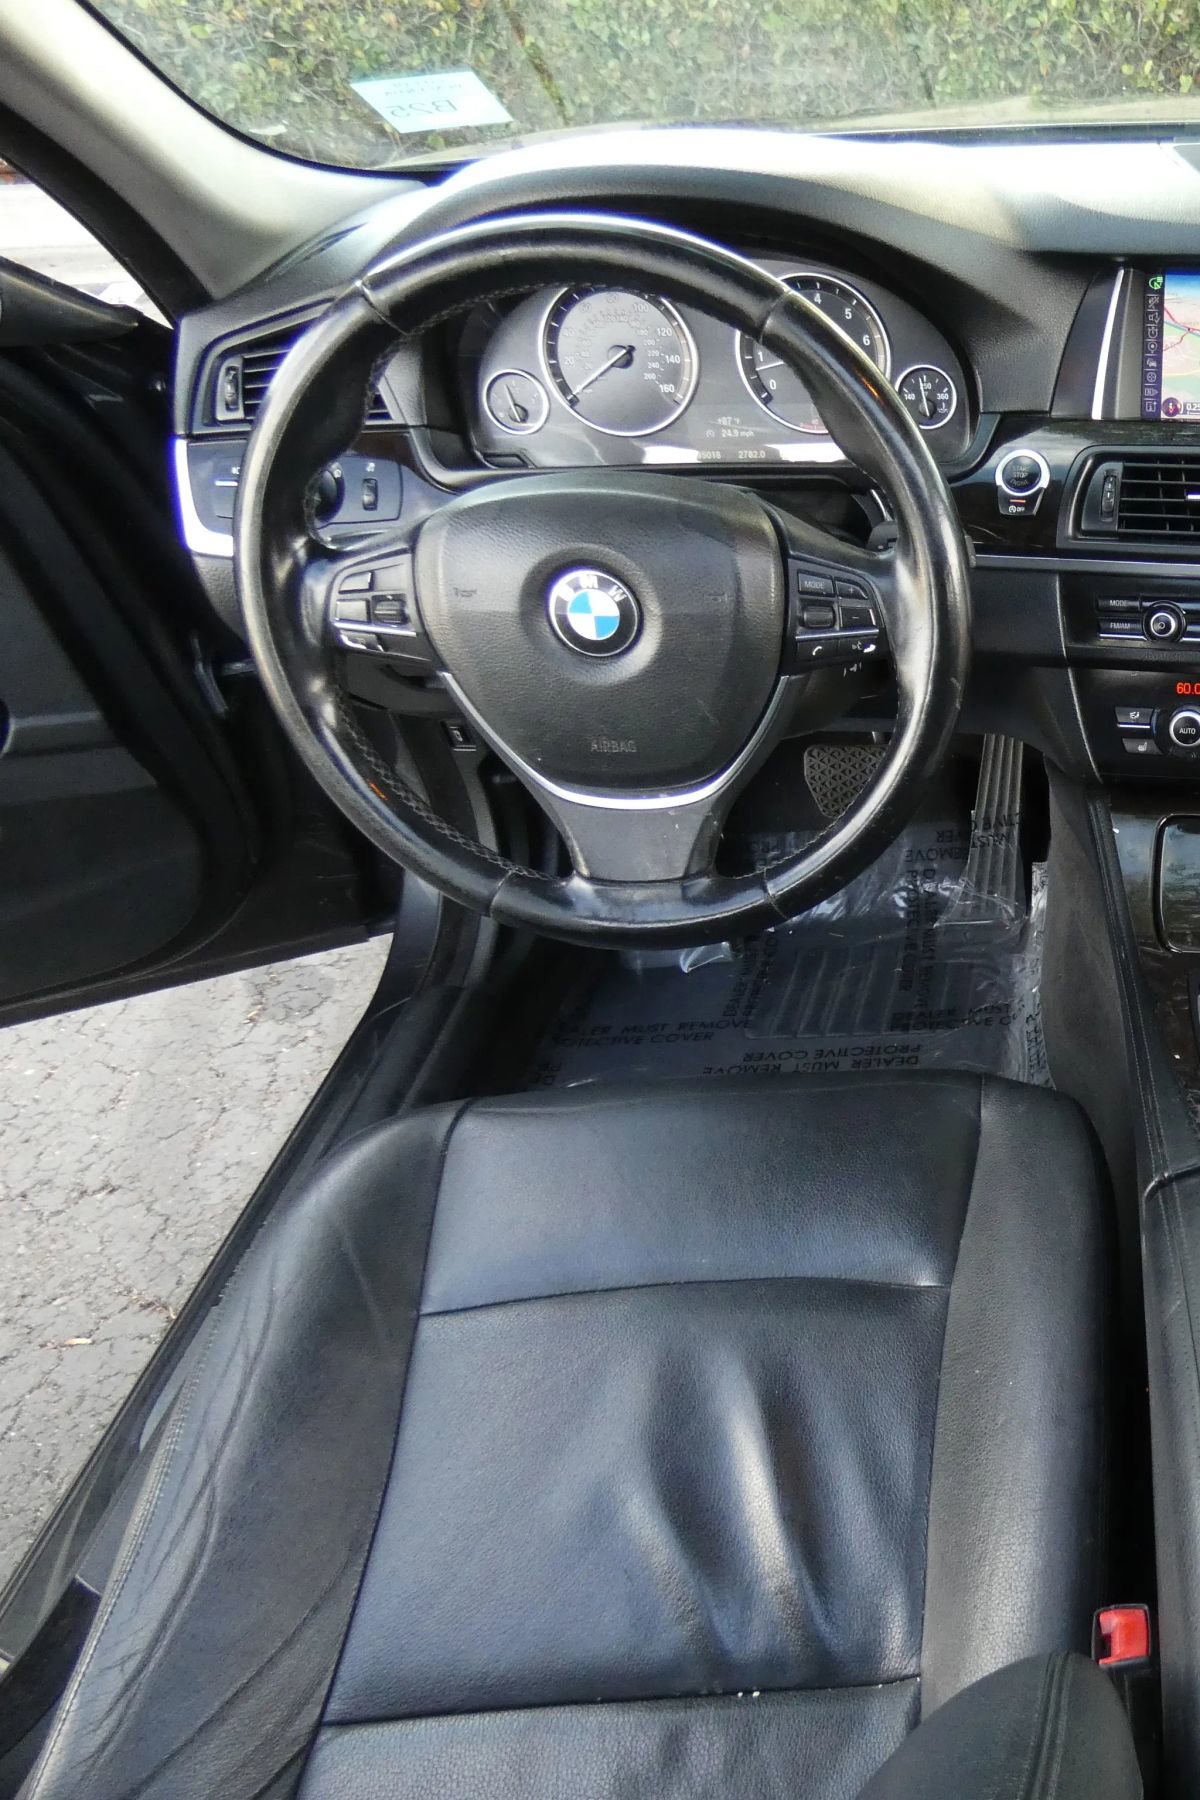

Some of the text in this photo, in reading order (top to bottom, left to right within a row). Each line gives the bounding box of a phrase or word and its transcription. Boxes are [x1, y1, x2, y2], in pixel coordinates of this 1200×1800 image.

[814, 293, 821, 304] 4
[845, 308, 852, 320] 5
[657, 328, 673, 336] 120
[863, 335, 871, 346] 6
[665, 355, 680, 364] 140
[758, 351, 764, 361] 1
[659, 384, 675, 393] 160
[769, 379, 777, 390] 0
[1179, 727, 1196, 735] AUTO
[651, 1032, 714, 1042] COVER
[743, 1050, 808, 1062] COVER
